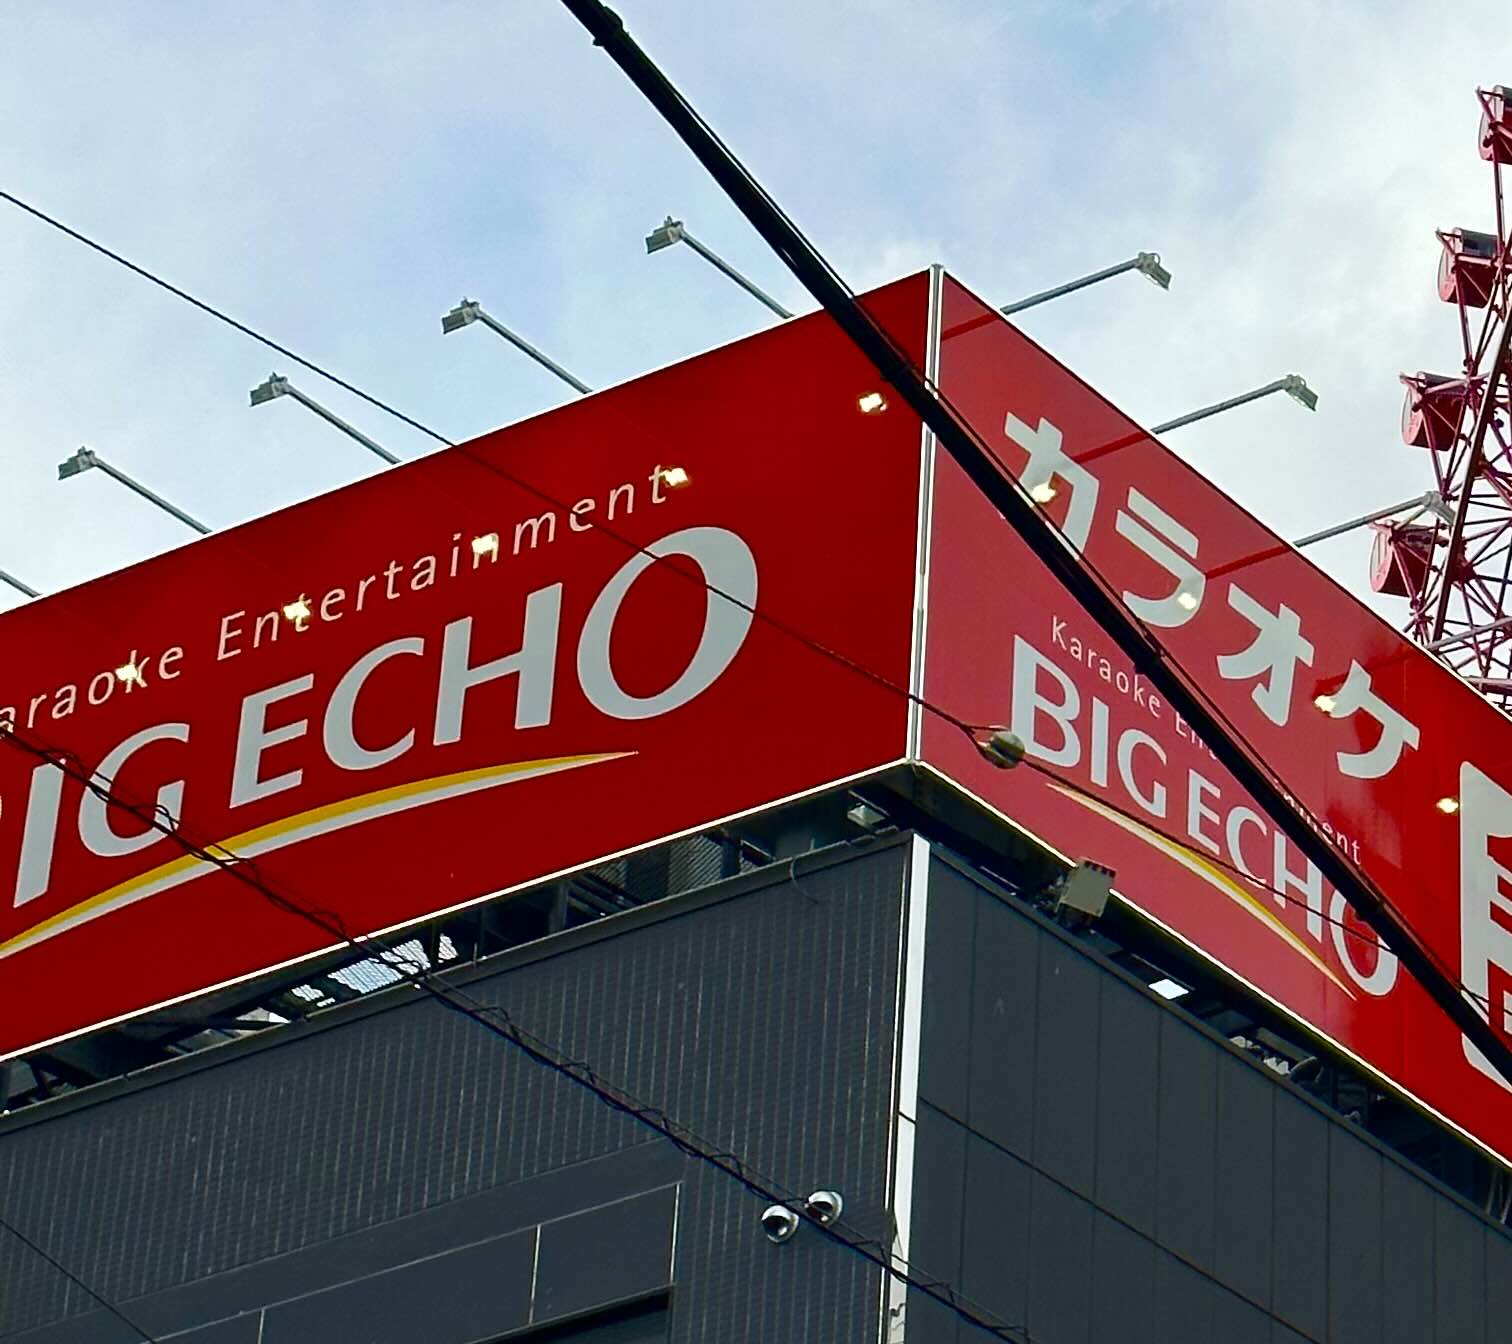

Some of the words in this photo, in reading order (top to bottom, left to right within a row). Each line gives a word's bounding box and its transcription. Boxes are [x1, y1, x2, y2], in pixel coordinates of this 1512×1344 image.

[0, 649, 184, 738] araoke
[217, 464, 672, 662] Entertainment
[0, 722, 190, 909] IG
[229, 525, 759, 809] ECHO
[1002, 414, 1420, 781] カラオケ
[1051, 615, 1162, 720] Karaoke
[1010, 633, 1168, 819] BIG
[1187, 768, 1399, 998] ECHO
